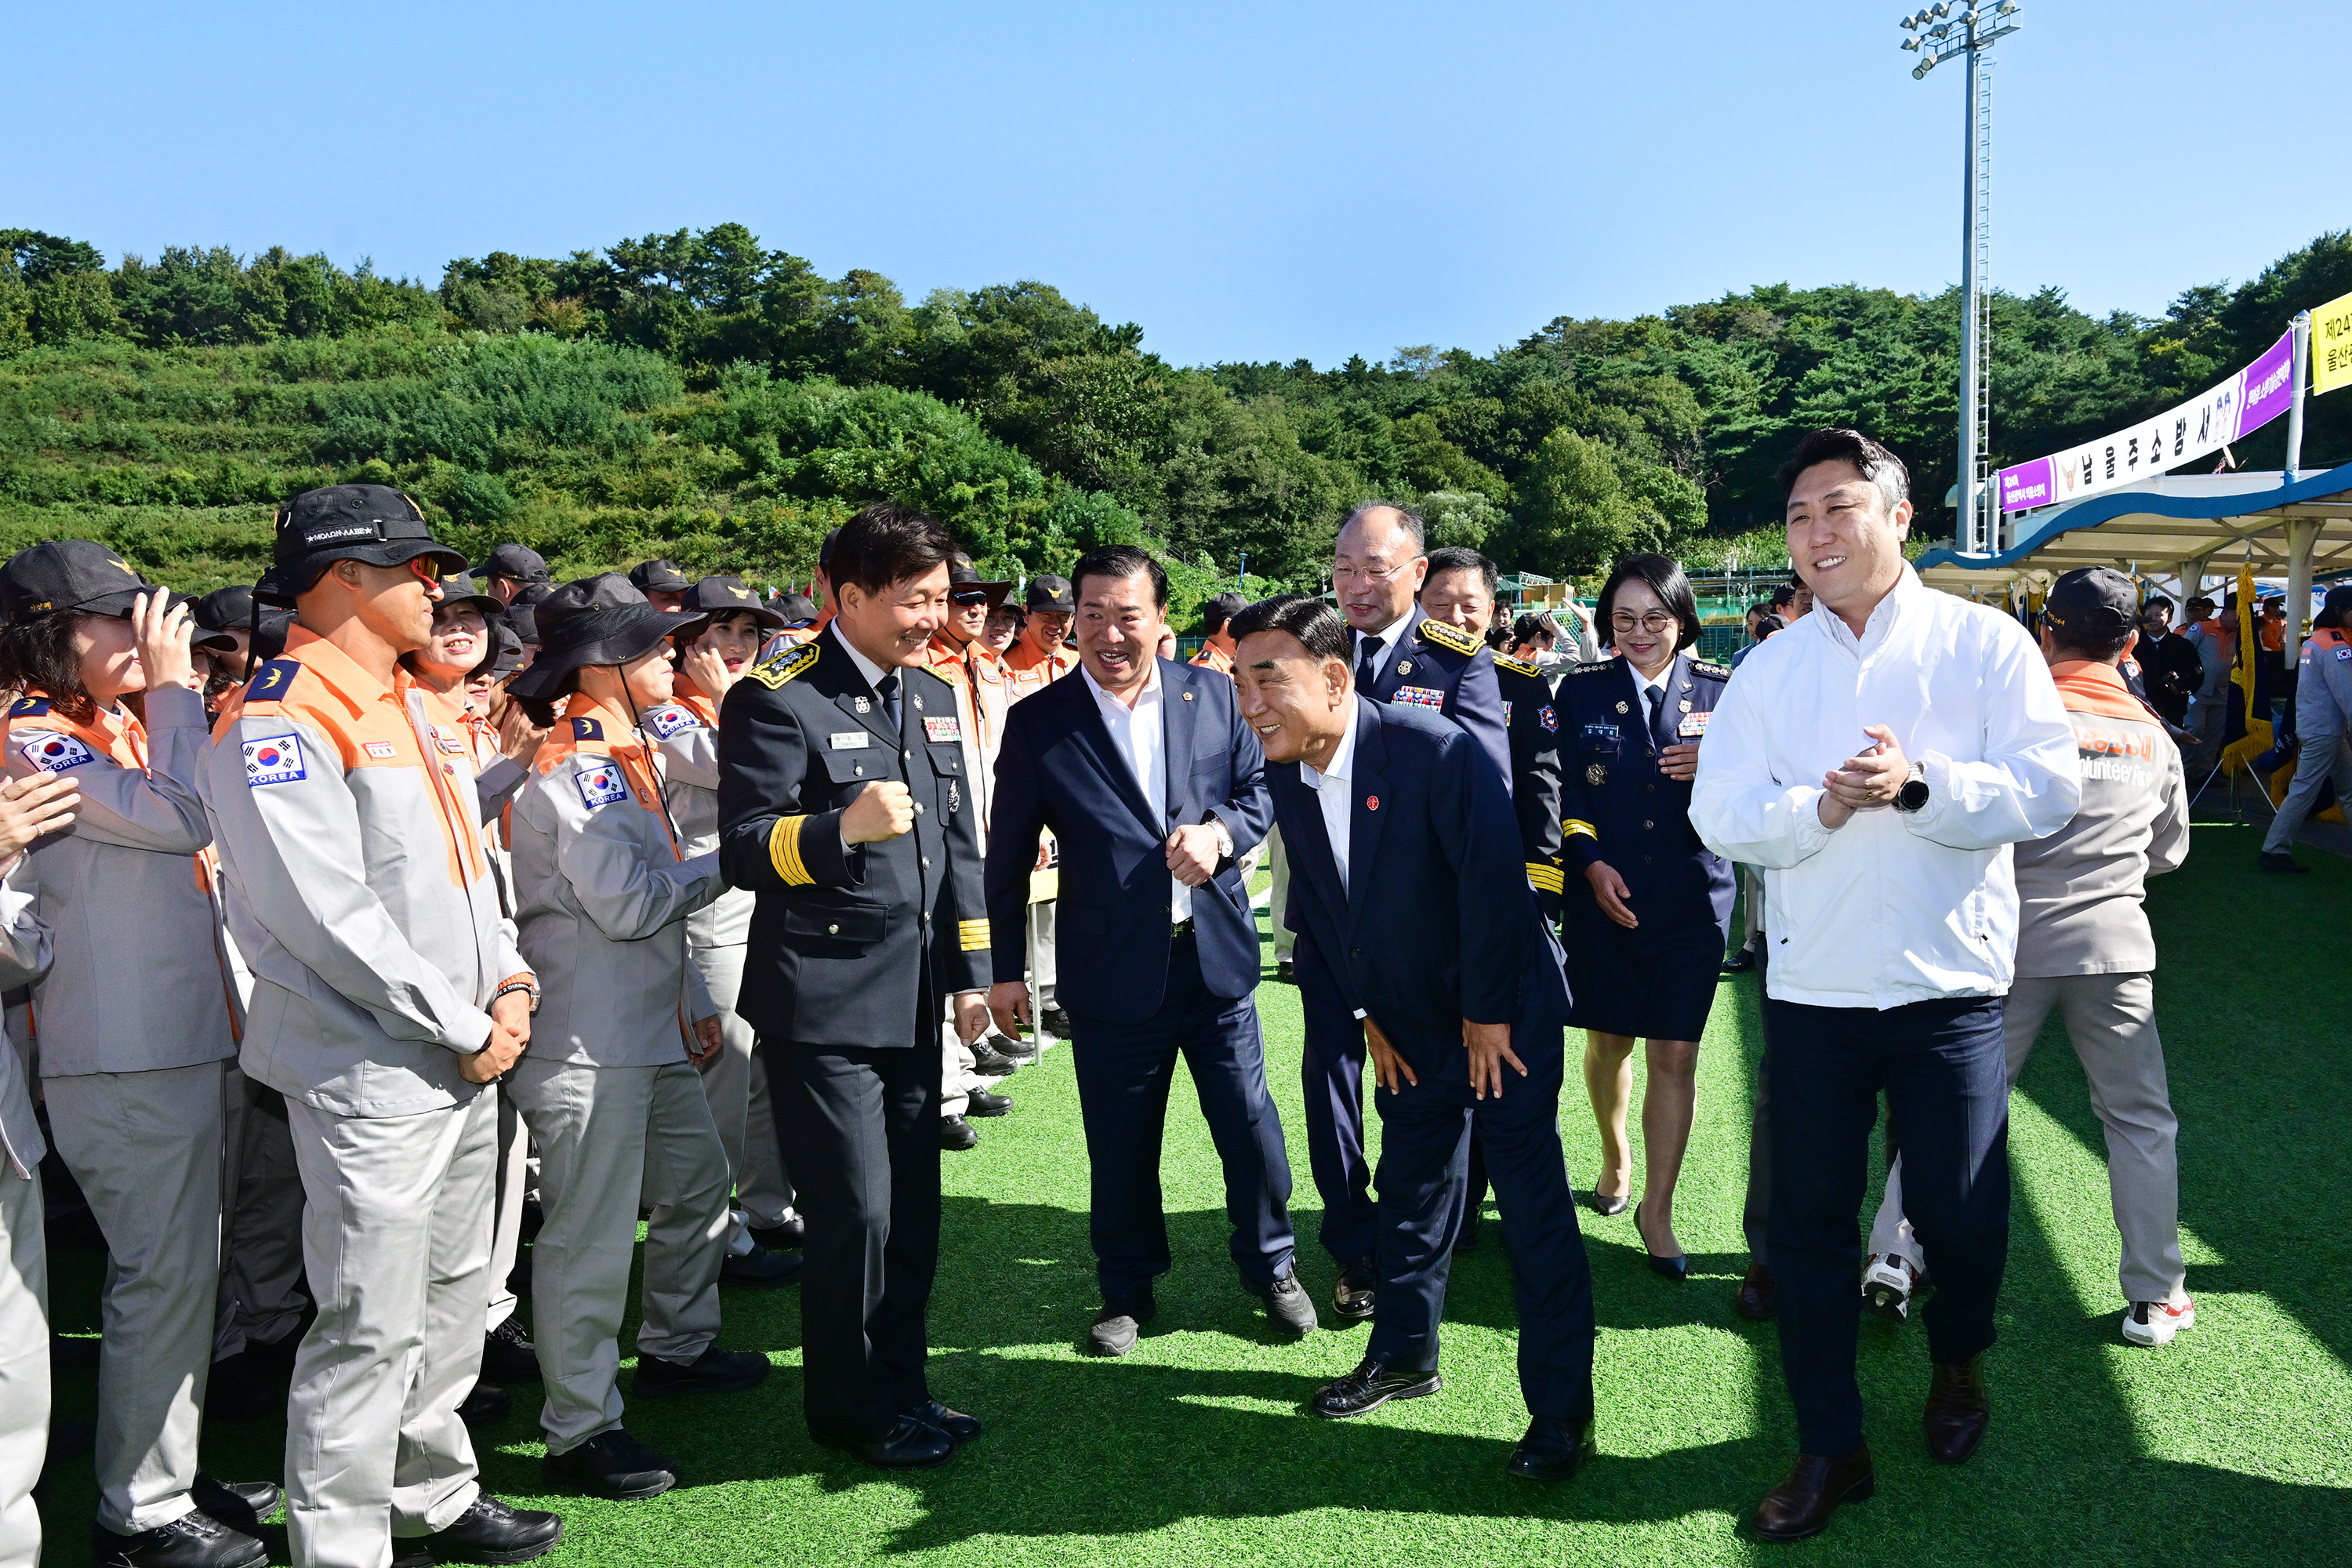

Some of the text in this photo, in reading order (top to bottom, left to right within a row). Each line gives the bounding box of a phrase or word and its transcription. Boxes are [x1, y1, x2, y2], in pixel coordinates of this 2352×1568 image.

[2325, 314, 2352, 340] 제24
[45, 756, 87, 771] KOREA
[250, 771, 299, 784] KOREA
[590, 793, 622, 806] KOREA
